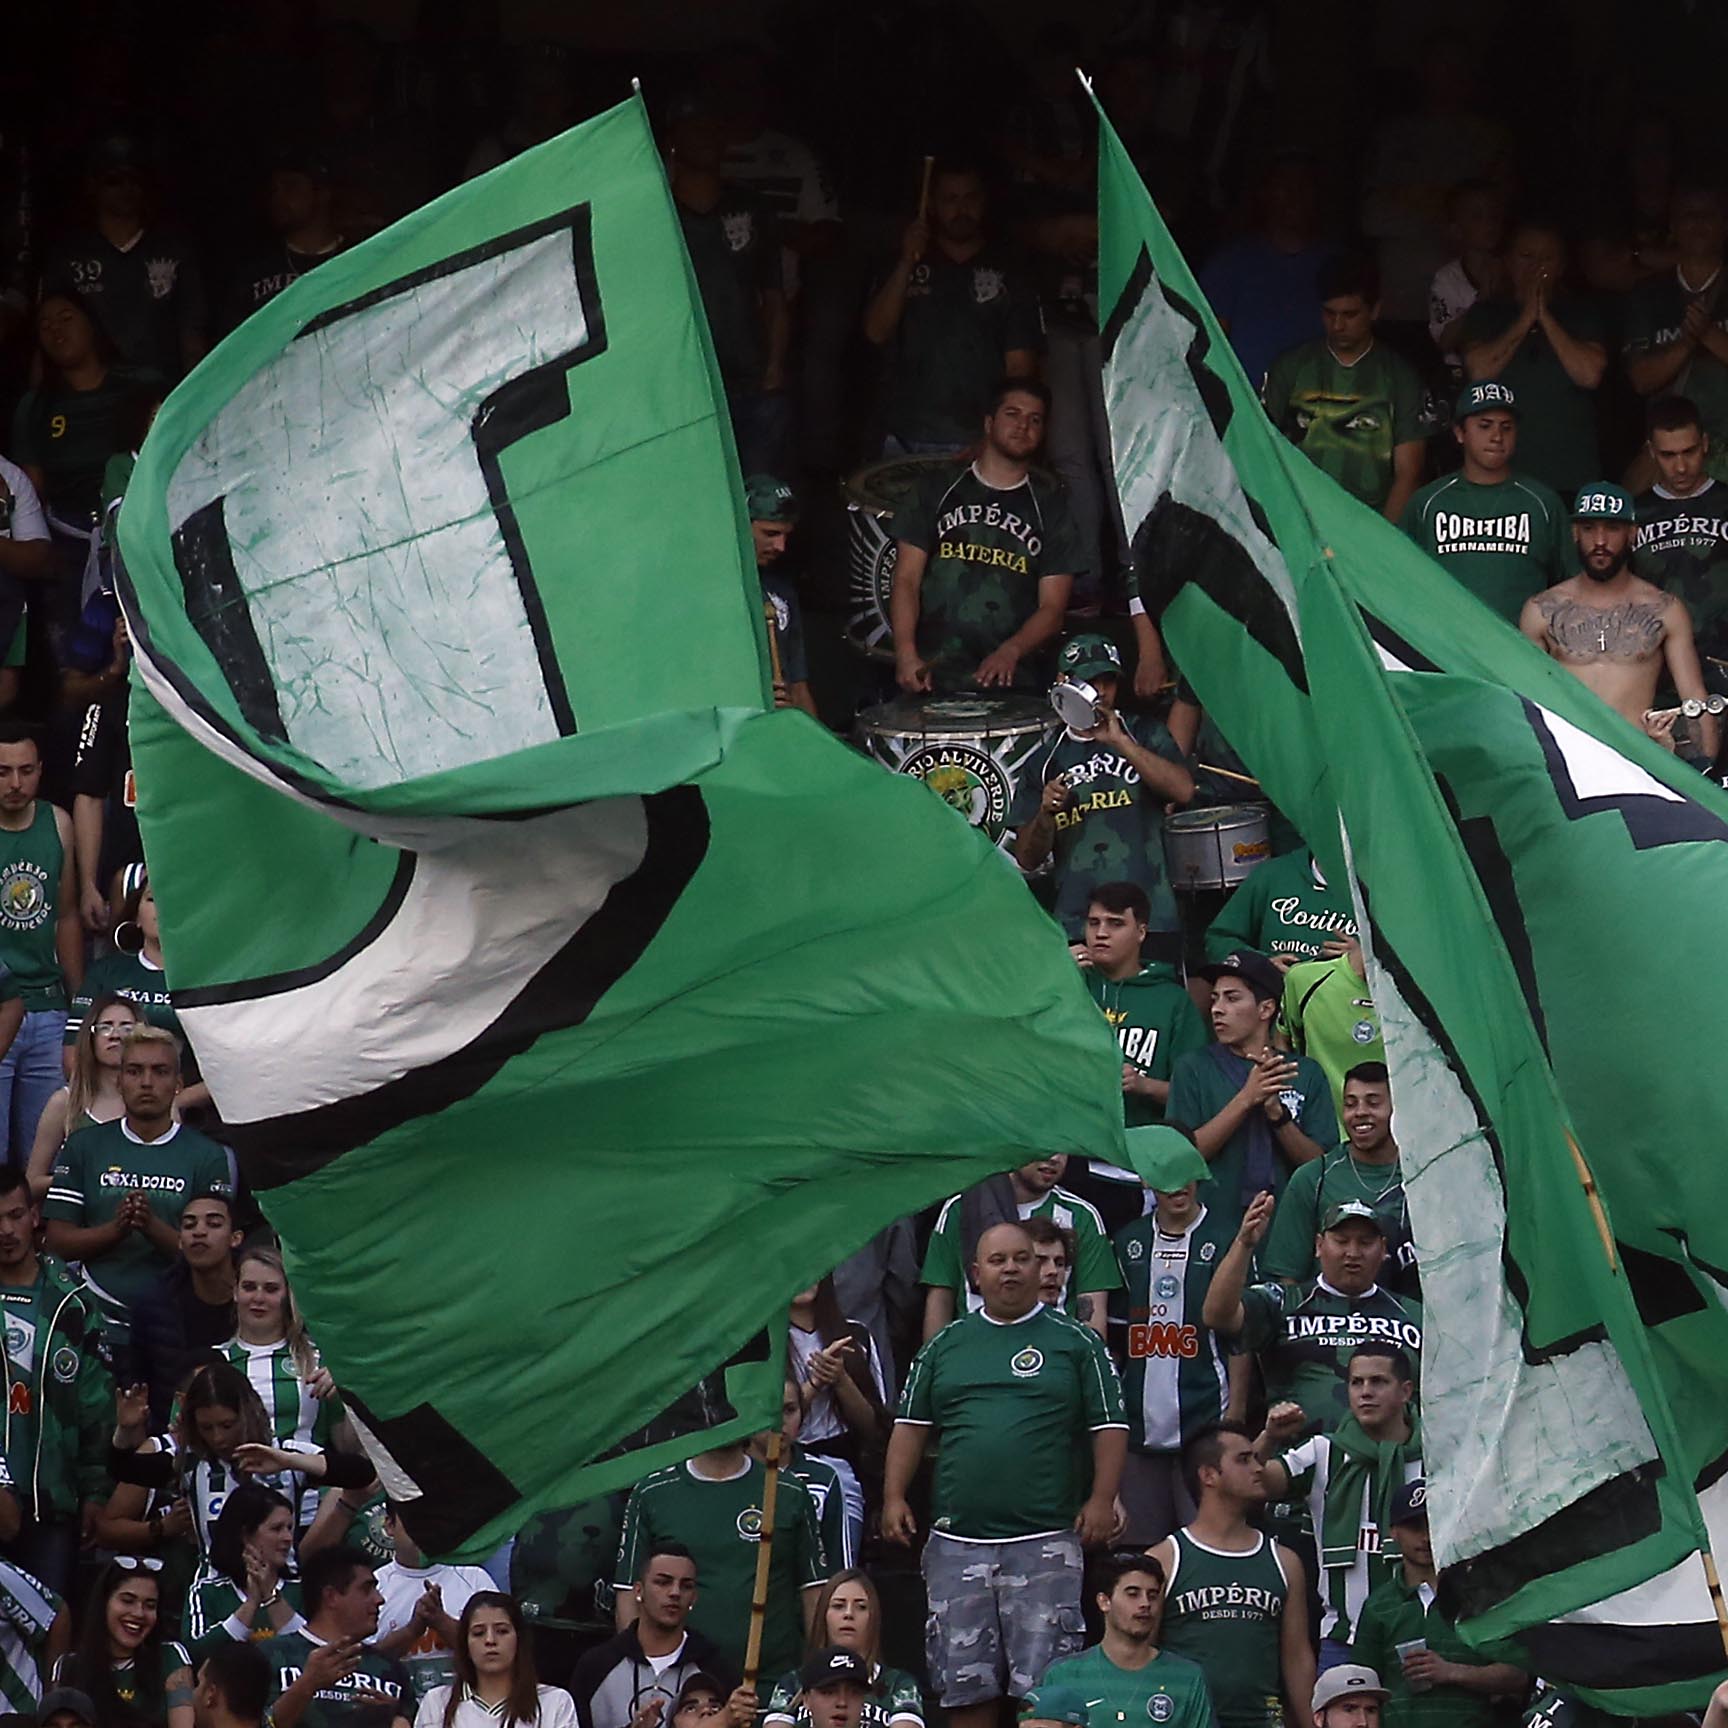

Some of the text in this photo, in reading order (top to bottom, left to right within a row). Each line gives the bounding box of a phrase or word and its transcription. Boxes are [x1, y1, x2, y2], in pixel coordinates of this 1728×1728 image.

[937, 503, 1042, 557] IMPÉRIO
[1435, 511, 1530, 544] CORITIBA
[939, 541, 1028, 575] BATERIA
[1438, 543, 1529, 556] ETERNAMENTE
[142, 1174, 186, 1192] DOIDO
[1129, 1323, 1199, 1358] BMG
[1287, 1311, 1422, 1349] IMPÉRIO
[1176, 1583, 1281, 1617] IMPÉRIO
[1202, 1608, 1239, 1621] DESDE
